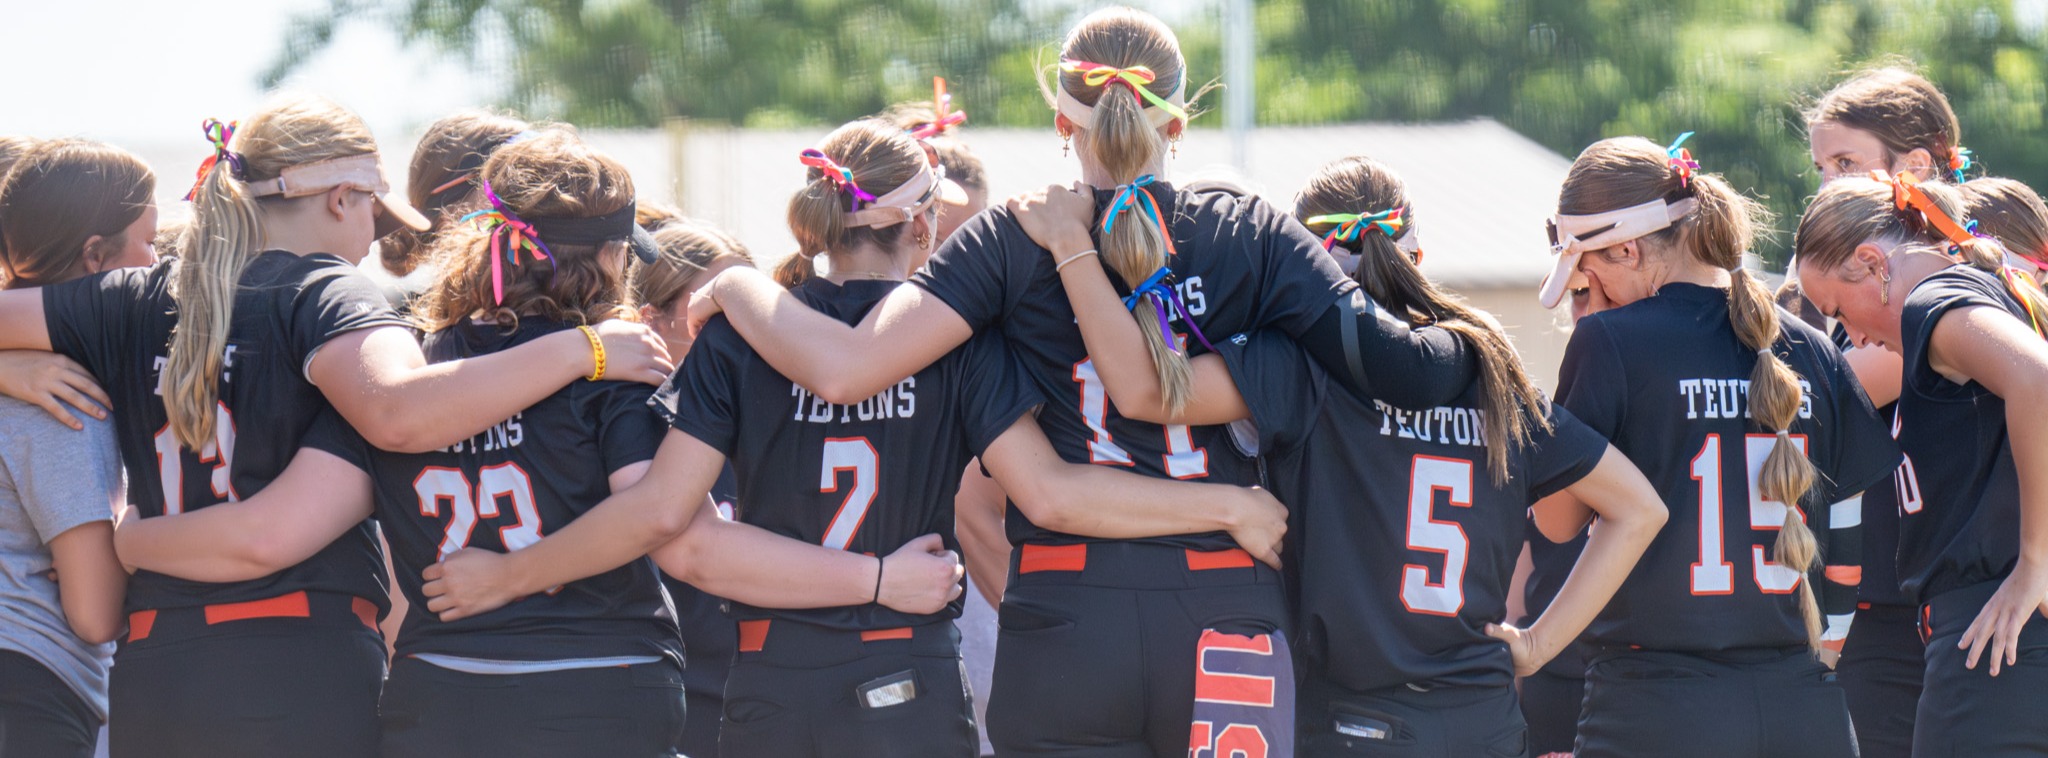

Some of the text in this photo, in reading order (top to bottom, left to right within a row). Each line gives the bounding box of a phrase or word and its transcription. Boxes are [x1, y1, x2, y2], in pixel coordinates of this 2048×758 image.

[792, 375, 916, 424] TEONS
[1373, 398, 1488, 447] TEUTON
[1679, 378, 1812, 419] TEUTS
[1399, 454, 1473, 617] 5
[1690, 433, 1808, 595] 15
